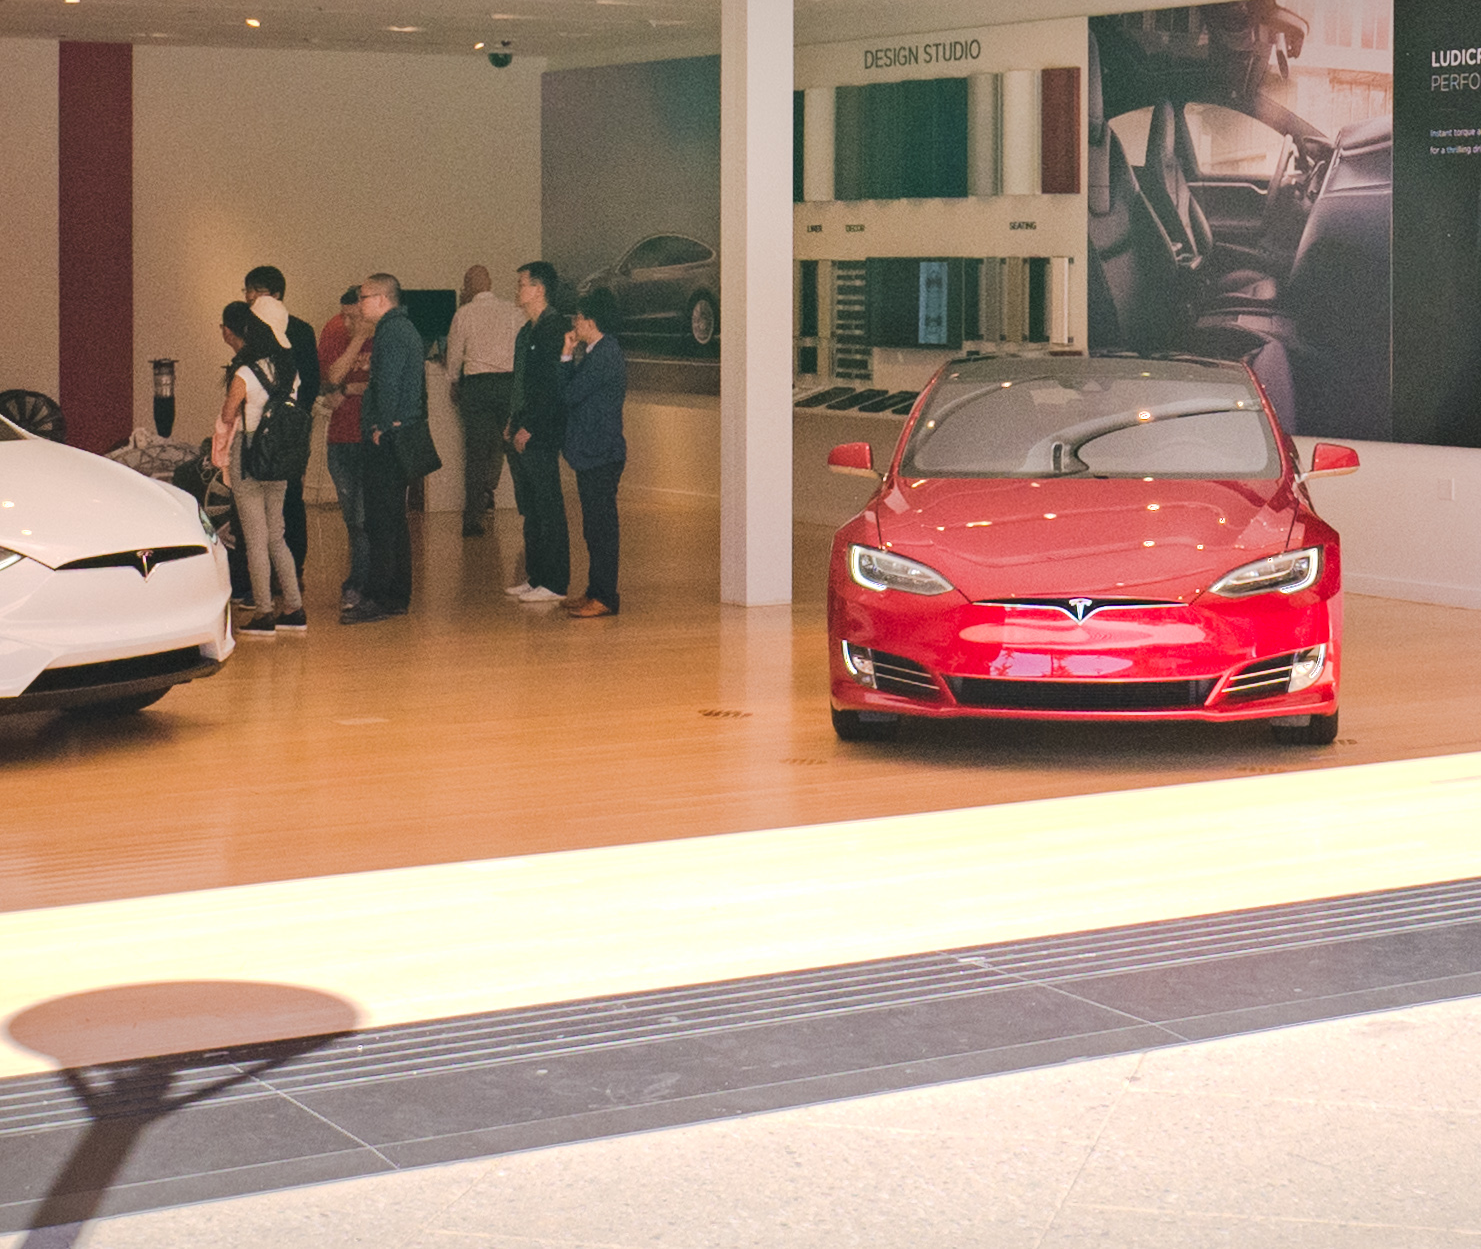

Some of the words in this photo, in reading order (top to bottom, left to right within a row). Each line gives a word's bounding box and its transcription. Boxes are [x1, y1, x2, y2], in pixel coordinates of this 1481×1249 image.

[864, 46, 919, 69] DESIGN
[923, 39, 981, 63] STUDIO
[1430, 129, 1452, 138] Instant
[1453, 129, 1476, 138] torque
[1430, 146, 1440, 155] for
[1446, 145, 1472, 155] thrilling
[1009, 221, 1037, 230] SEATING
